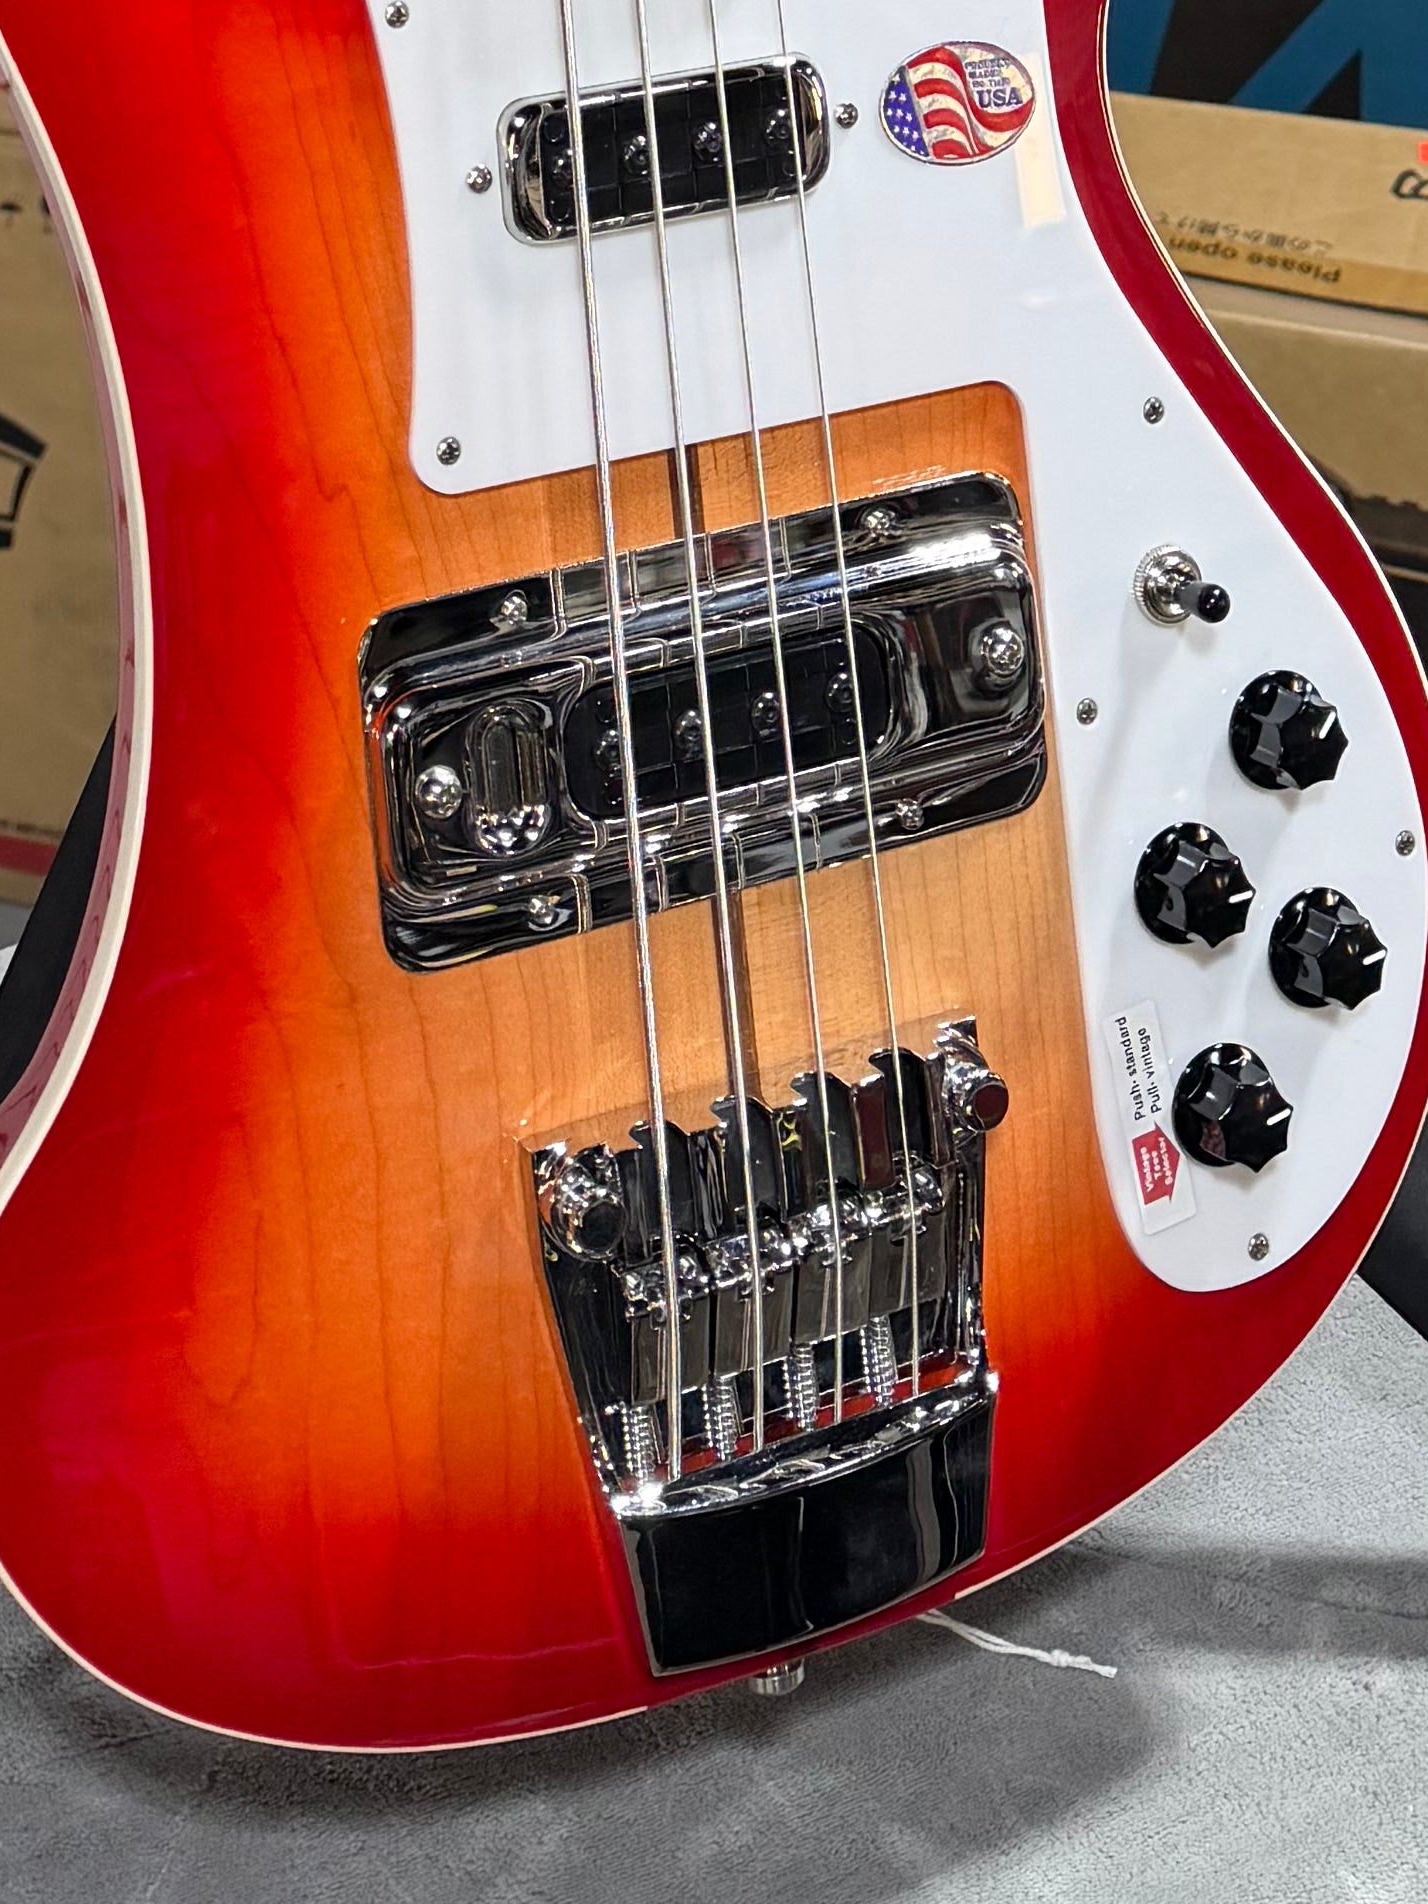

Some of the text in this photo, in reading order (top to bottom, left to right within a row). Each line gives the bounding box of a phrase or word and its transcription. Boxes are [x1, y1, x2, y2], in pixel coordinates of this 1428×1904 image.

[976, 87, 1023, 109] USA
[1168, 236, 1342, 284] Please open
[1115, 1016, 1138, 1076] standard
[1138, 1027, 1155, 1080] vintage
[1140, 1147, 1154, 1192] Vintage
[1151, 1151, 1162, 1180] Tone
[1159, 1136, 1173, 1185] Selector
